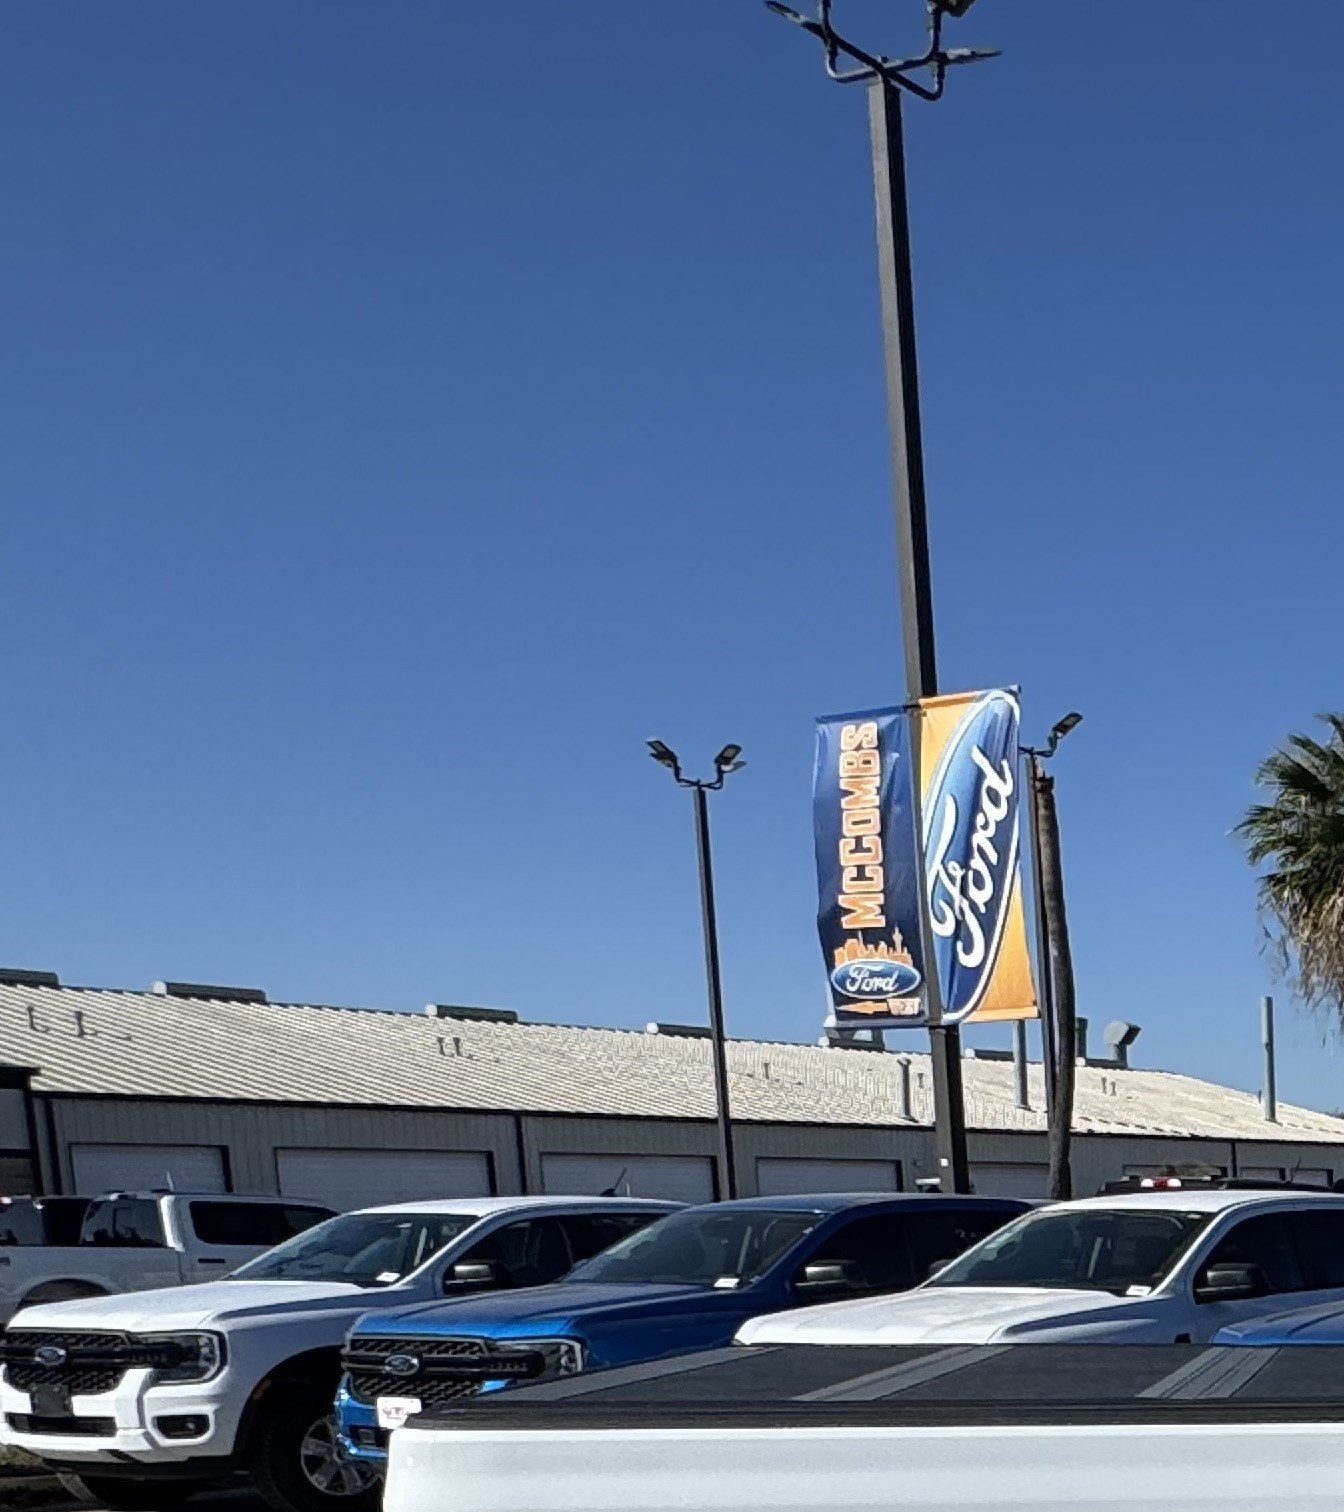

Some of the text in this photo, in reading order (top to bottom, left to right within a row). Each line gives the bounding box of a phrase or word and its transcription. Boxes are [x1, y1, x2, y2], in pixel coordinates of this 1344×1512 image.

[838, 721, 886, 929] MCCOMBS
[928, 744, 1014, 968] Ford
[845, 963, 900, 992] Ford
